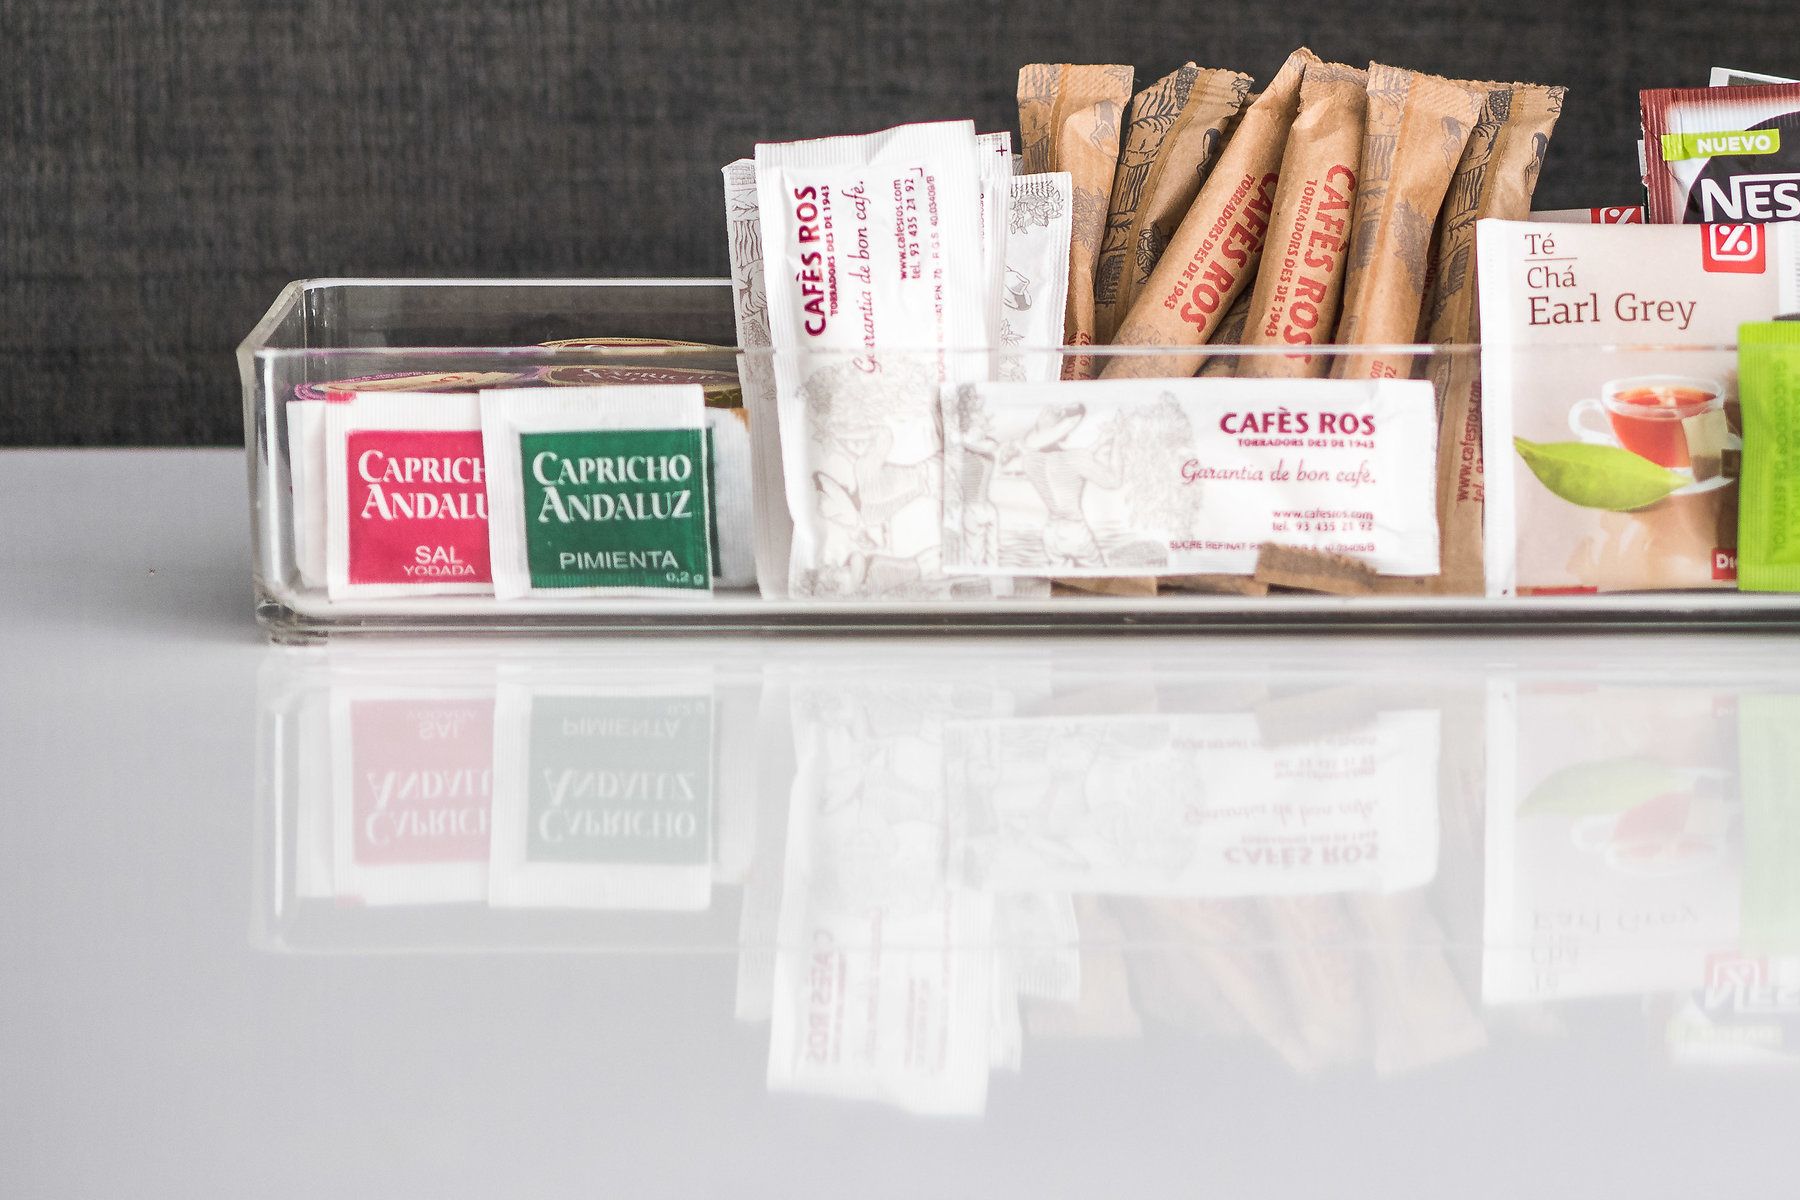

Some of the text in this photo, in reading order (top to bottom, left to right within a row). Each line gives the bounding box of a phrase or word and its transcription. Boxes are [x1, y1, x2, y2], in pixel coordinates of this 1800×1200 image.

[1696, 134, 1771, 154] NUEVO
[821, 185, 831, 211] 1943
[905, 178, 914, 193] 92
[907, 217, 917, 237] 435
[1287, 179, 1318, 257] TORRADORS
[847, 227, 870, 261] bon
[909, 242, 919, 257] 93
[1164, 174, 1256, 310] TORRADORS DES DE 1943
[1524, 233, 1555, 255] Té
[795, 186, 826, 337] CAFÈS ROS
[848, 265, 872, 285] de
[1279, 258, 1296, 282] DES
[1283, 164, 1356, 365] CAFÈS ROS
[1527, 267, 1576, 289] Chá
[1180, 260, 1235, 333] ROS
[1274, 284, 1289, 303] DE
[1528, 292, 1697, 330] Earl Grey
[1219, 407, 1376, 436] CAFÈS ROS
[358, 449, 487, 485] CAPRICH
[532, 451, 693, 487] CAPRICHO
[1180, 458, 1264, 487] Garantia
[1270, 459, 1290, 482] de
[1296, 459, 1330, 482] bon
[360, 484, 489, 521] ANDALU
[538, 484, 693, 524] ANDALUZ
[415, 545, 463, 565] SAL
[559, 550, 680, 570] PIMIENTA
